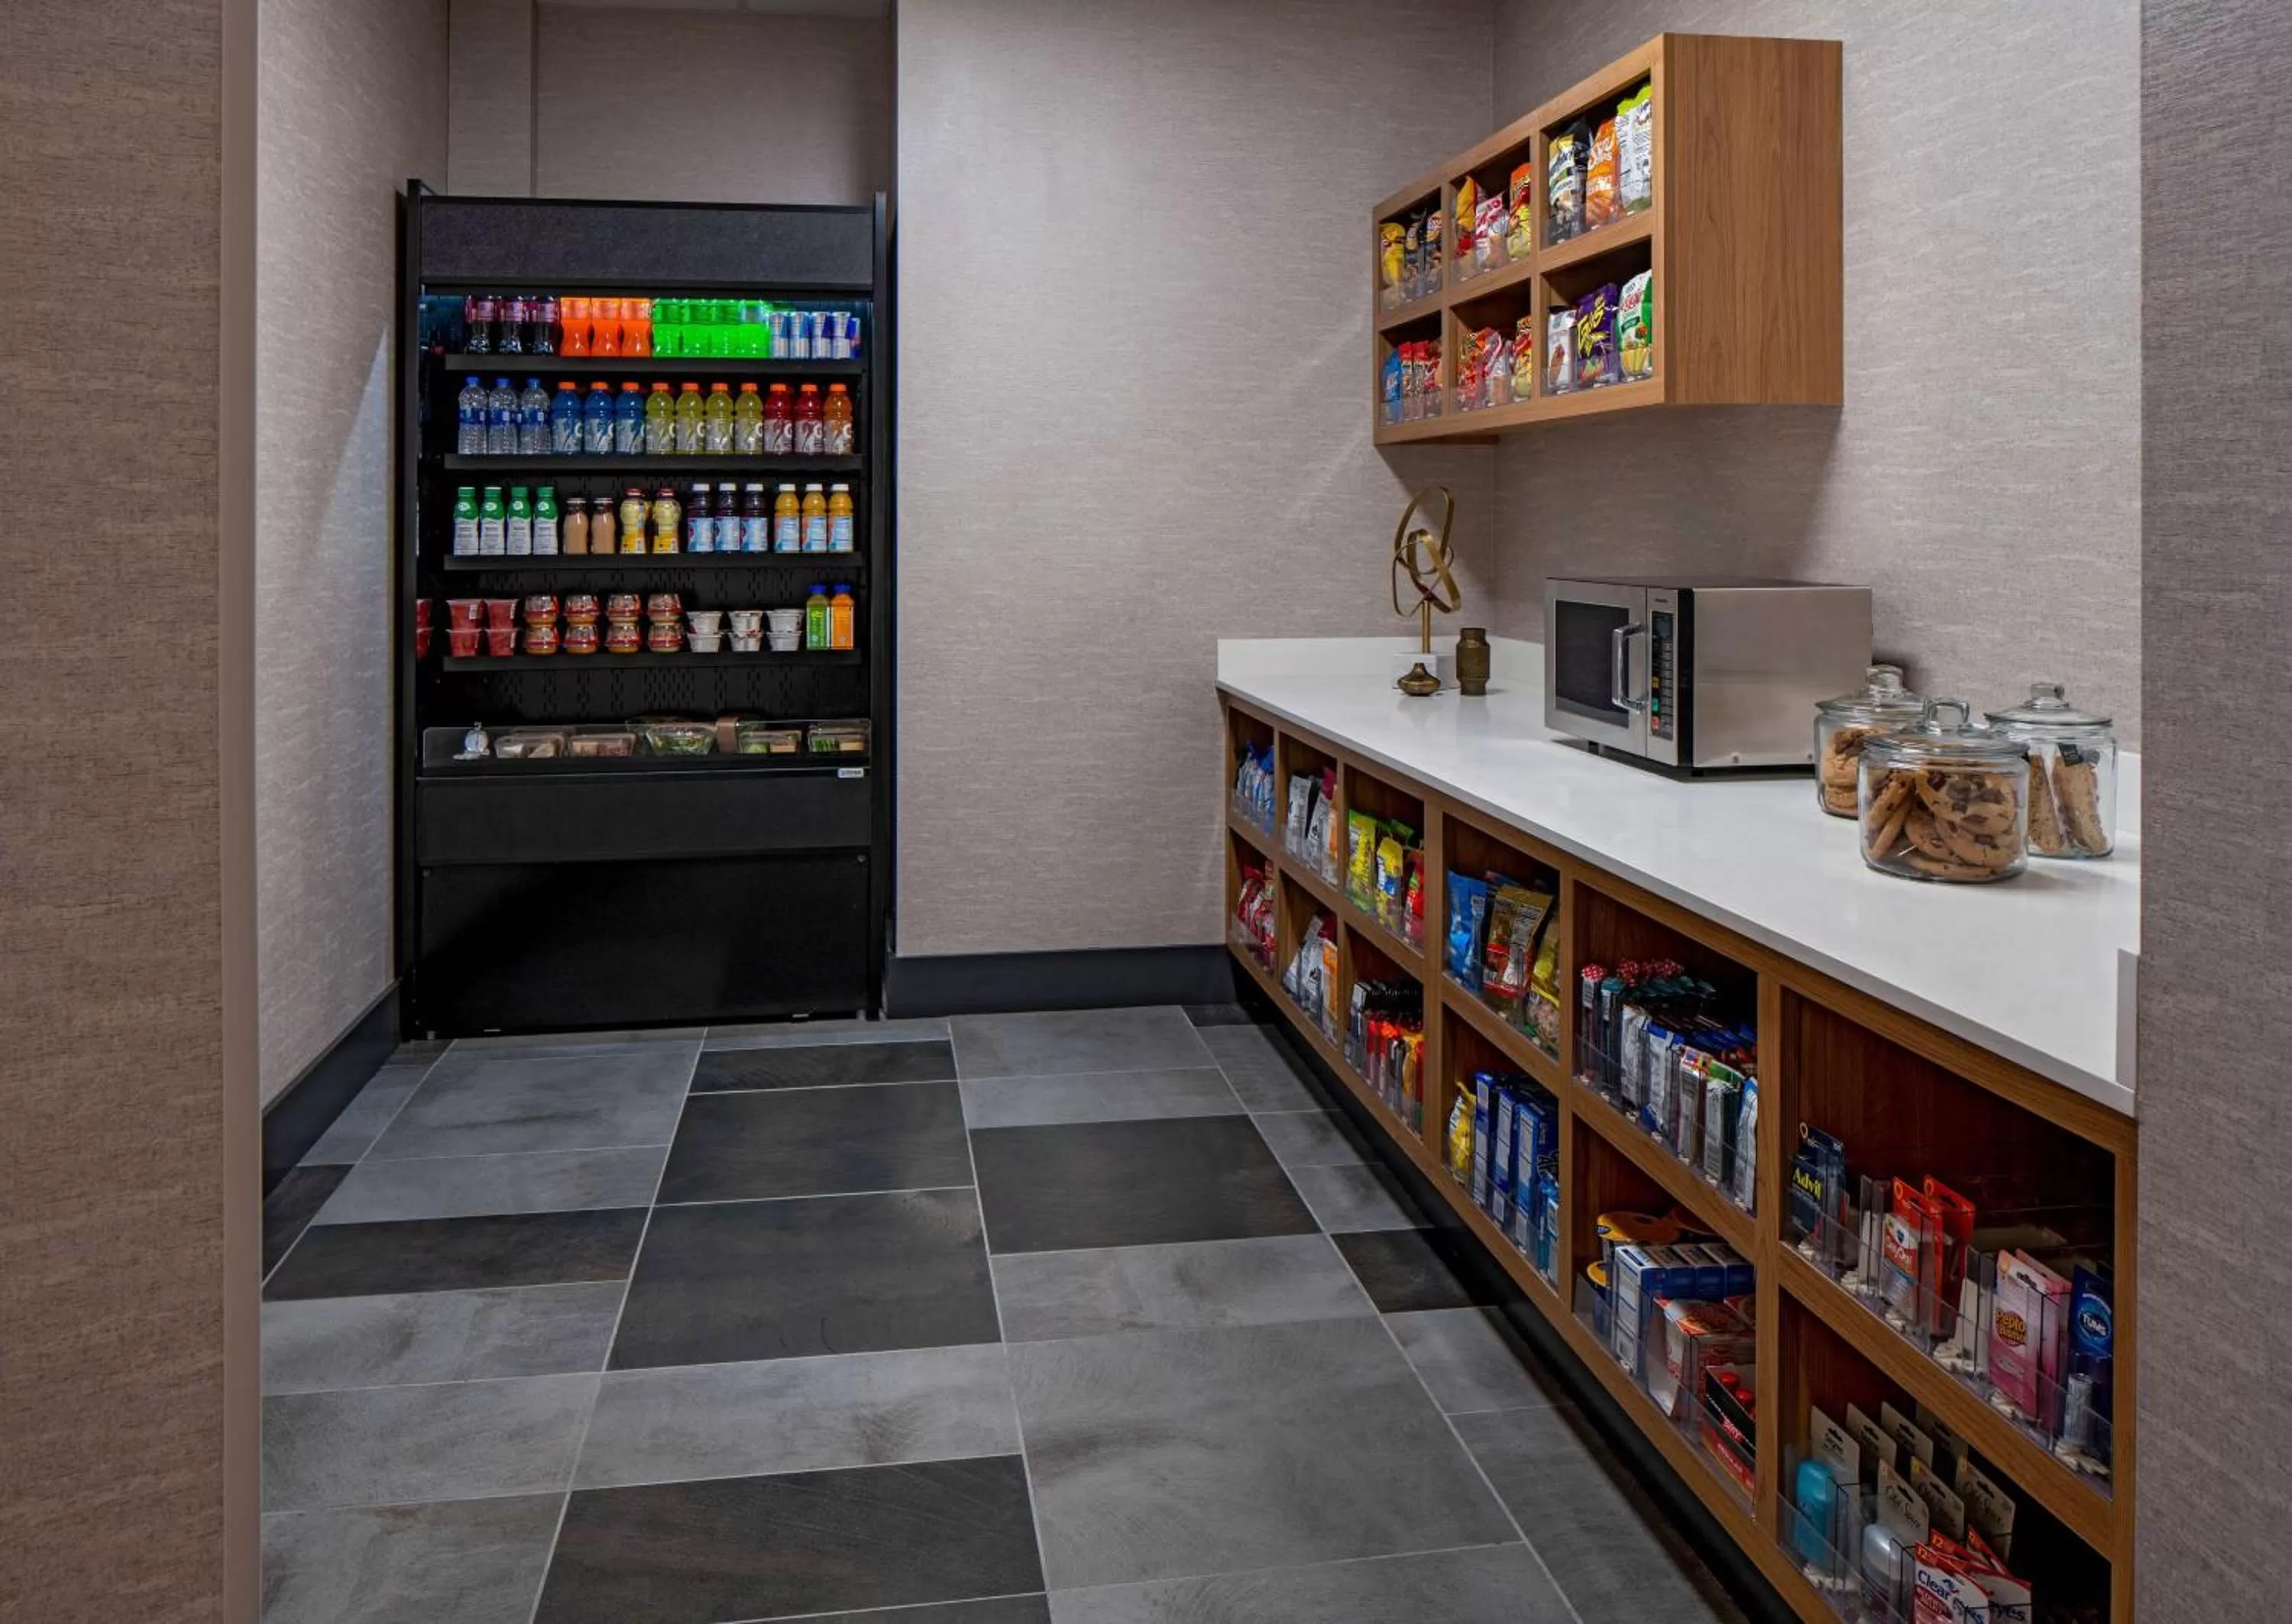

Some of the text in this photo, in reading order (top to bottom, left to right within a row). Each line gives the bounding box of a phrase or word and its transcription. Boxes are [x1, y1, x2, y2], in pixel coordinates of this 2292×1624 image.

[1792, 1166, 1822, 1199] Advil
[2083, 1313, 2106, 1337] TUMS
[1918, 1570, 1950, 1600] Clear
